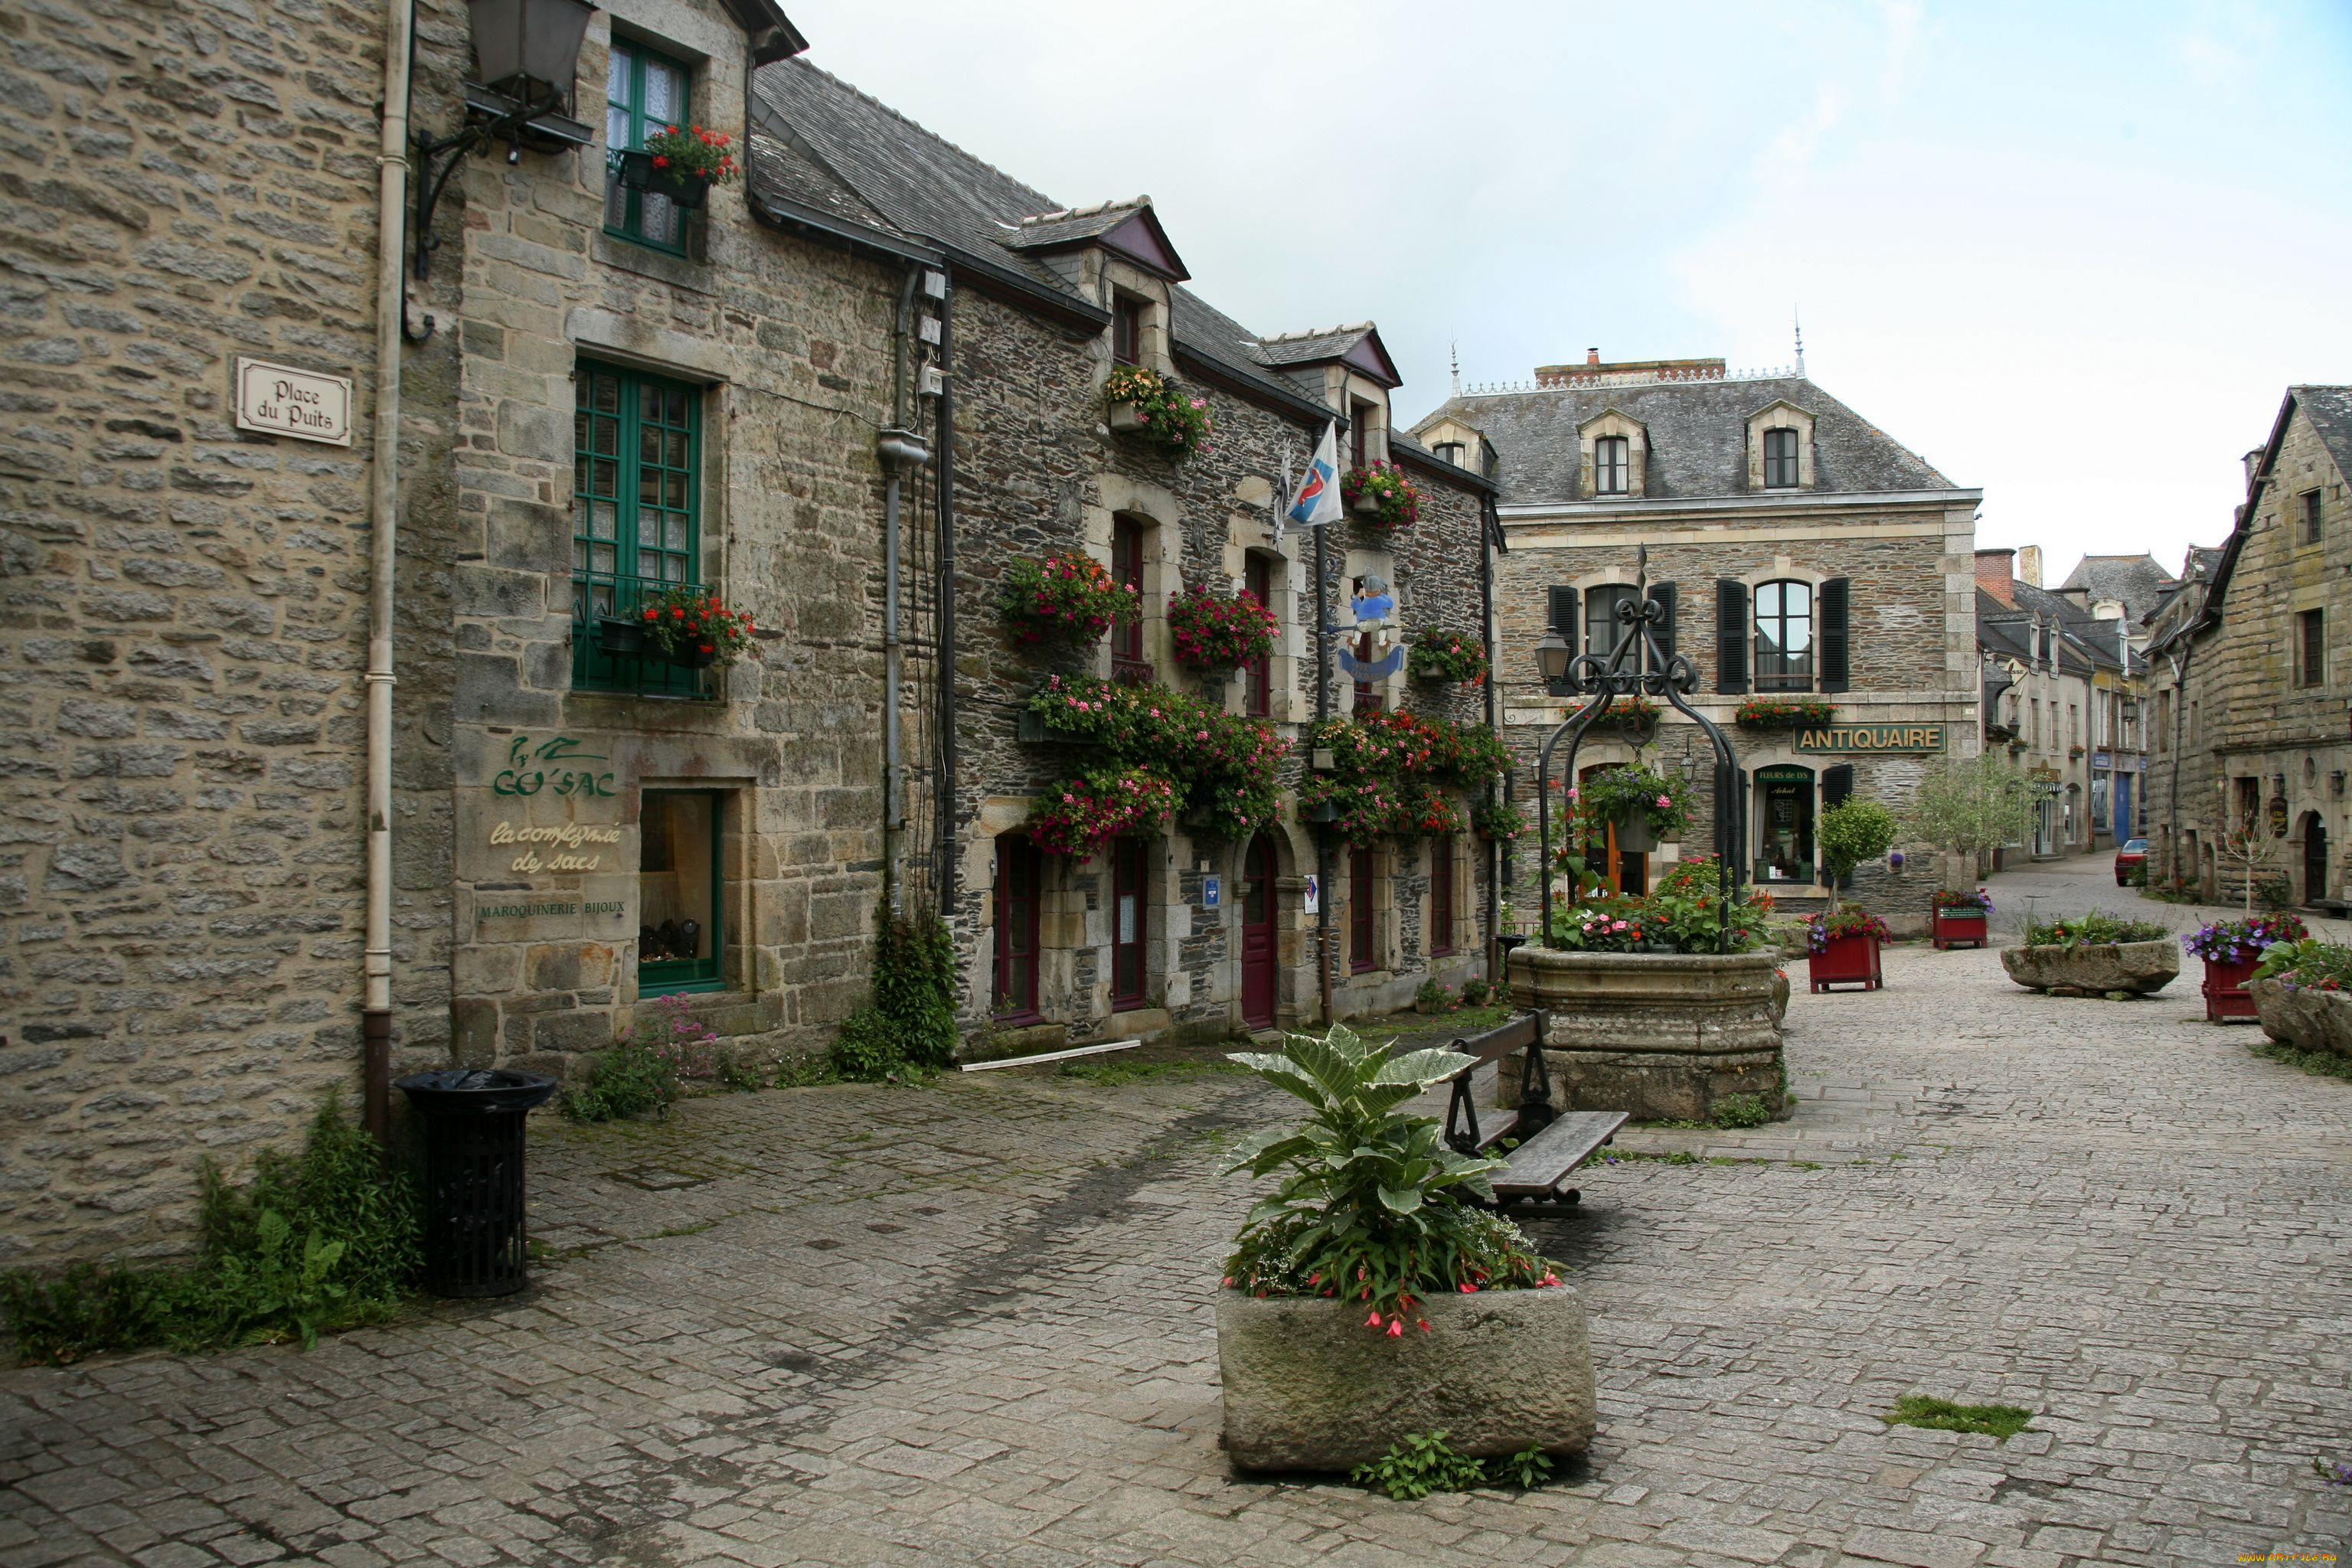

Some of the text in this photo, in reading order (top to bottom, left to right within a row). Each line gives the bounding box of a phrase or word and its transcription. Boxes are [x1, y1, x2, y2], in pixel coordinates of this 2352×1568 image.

[273, 380, 320, 404] Place
[257, 400, 332, 429] du Puits
[1800, 728, 1940, 748] ANTIQUAIRE
[490, 821, 516, 844] la
[511, 851, 600, 874] des sacs
[481, 901, 626, 918] MAROQUINERIE BIJOUX
